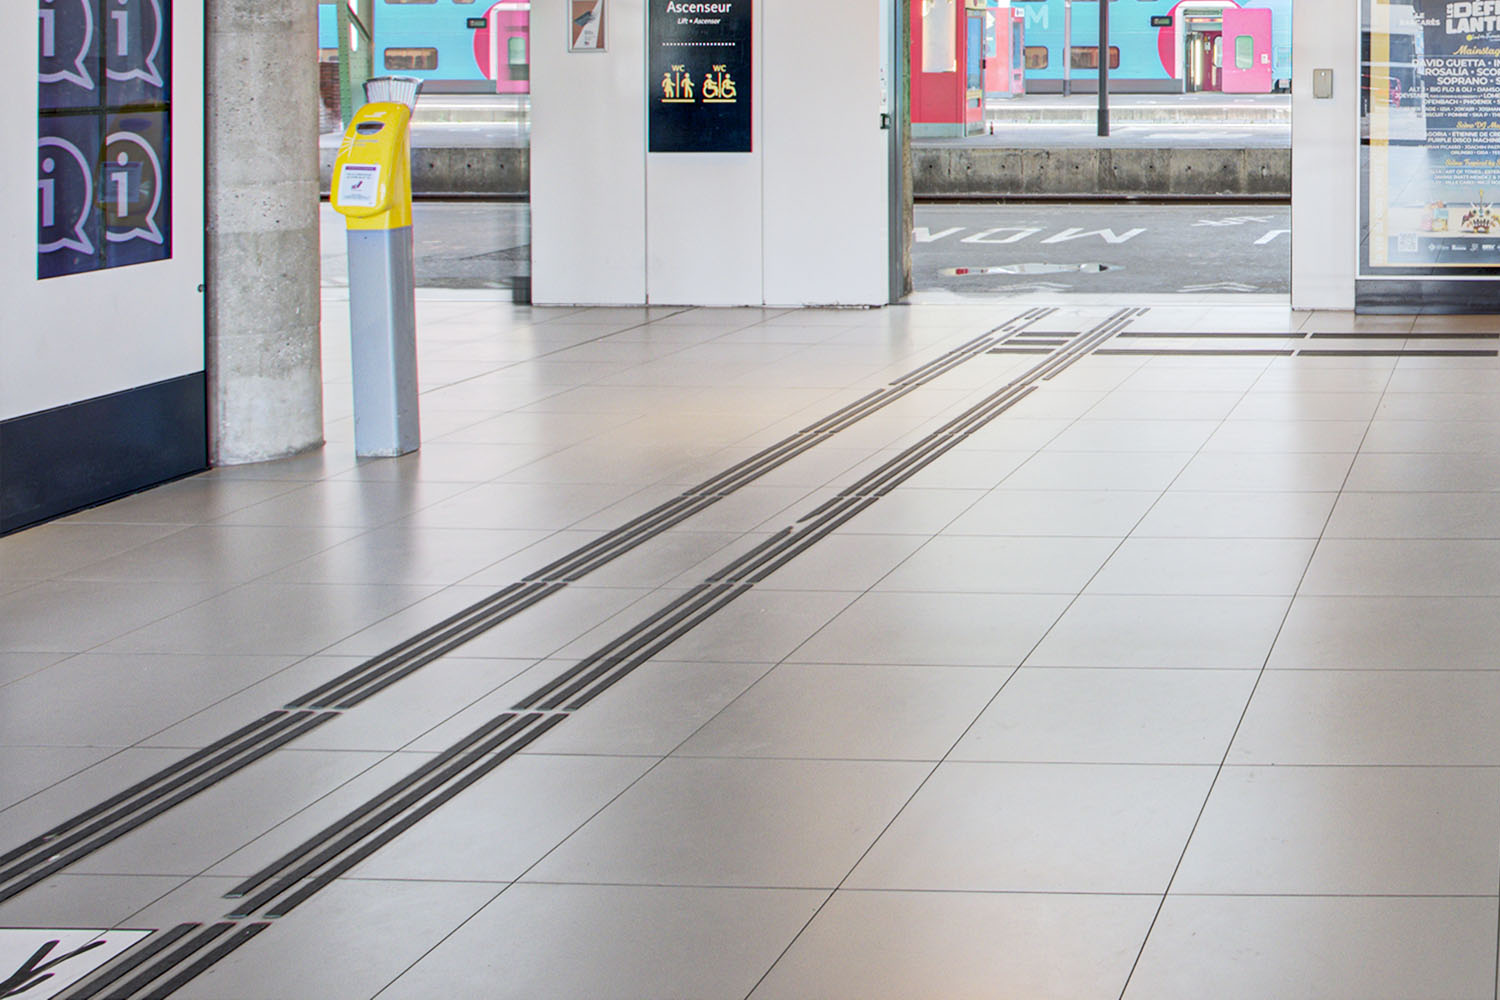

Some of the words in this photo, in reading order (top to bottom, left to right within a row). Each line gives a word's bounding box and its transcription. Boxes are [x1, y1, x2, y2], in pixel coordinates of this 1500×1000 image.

[666, 1, 732, 13] Ascenseur
[677, 17, 689, 25] Lift
[693, 17, 721, 25] Ascensor
[671, 64, 686, 72] WC
[712, 64, 727, 72] WC
[1412, 58, 1444, 68] DAVID
[1446, 58, 1487, 68] GUETTA
[1425, 66, 1469, 77] ROSALÍA
[1437, 76, 1488, 86] SOPRANO
